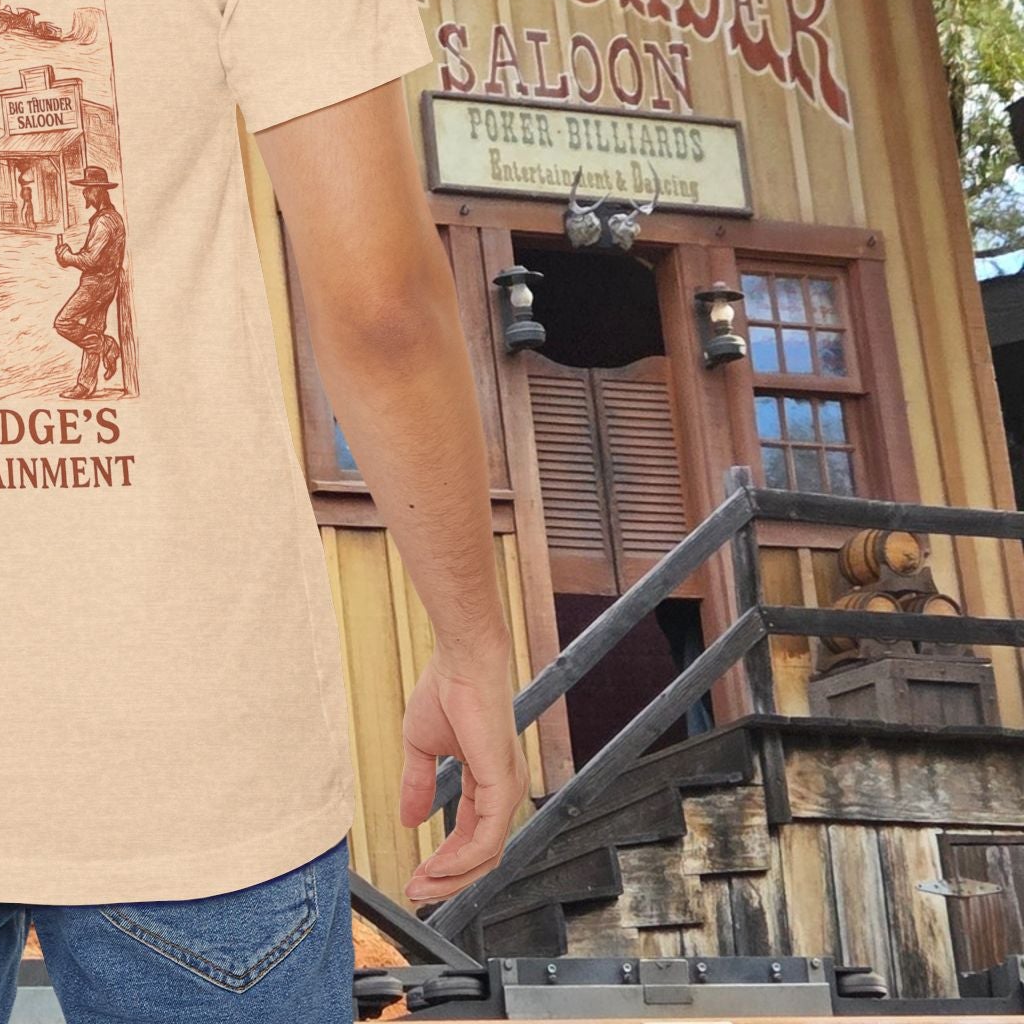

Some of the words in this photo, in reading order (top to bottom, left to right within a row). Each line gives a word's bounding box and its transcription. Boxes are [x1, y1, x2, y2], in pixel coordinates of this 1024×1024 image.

[438, 22, 692, 113] SALOON
[8, 101, 24, 115] BIG
[26, 96, 73, 114] THUNDER
[17, 112, 65, 129] SALOON
[467, 107, 554, 148] POKER
[565, 116, 705, 162] BILLIARDS
[615, 170, 629, 191] &
[630, 160, 700, 204] Dacing
